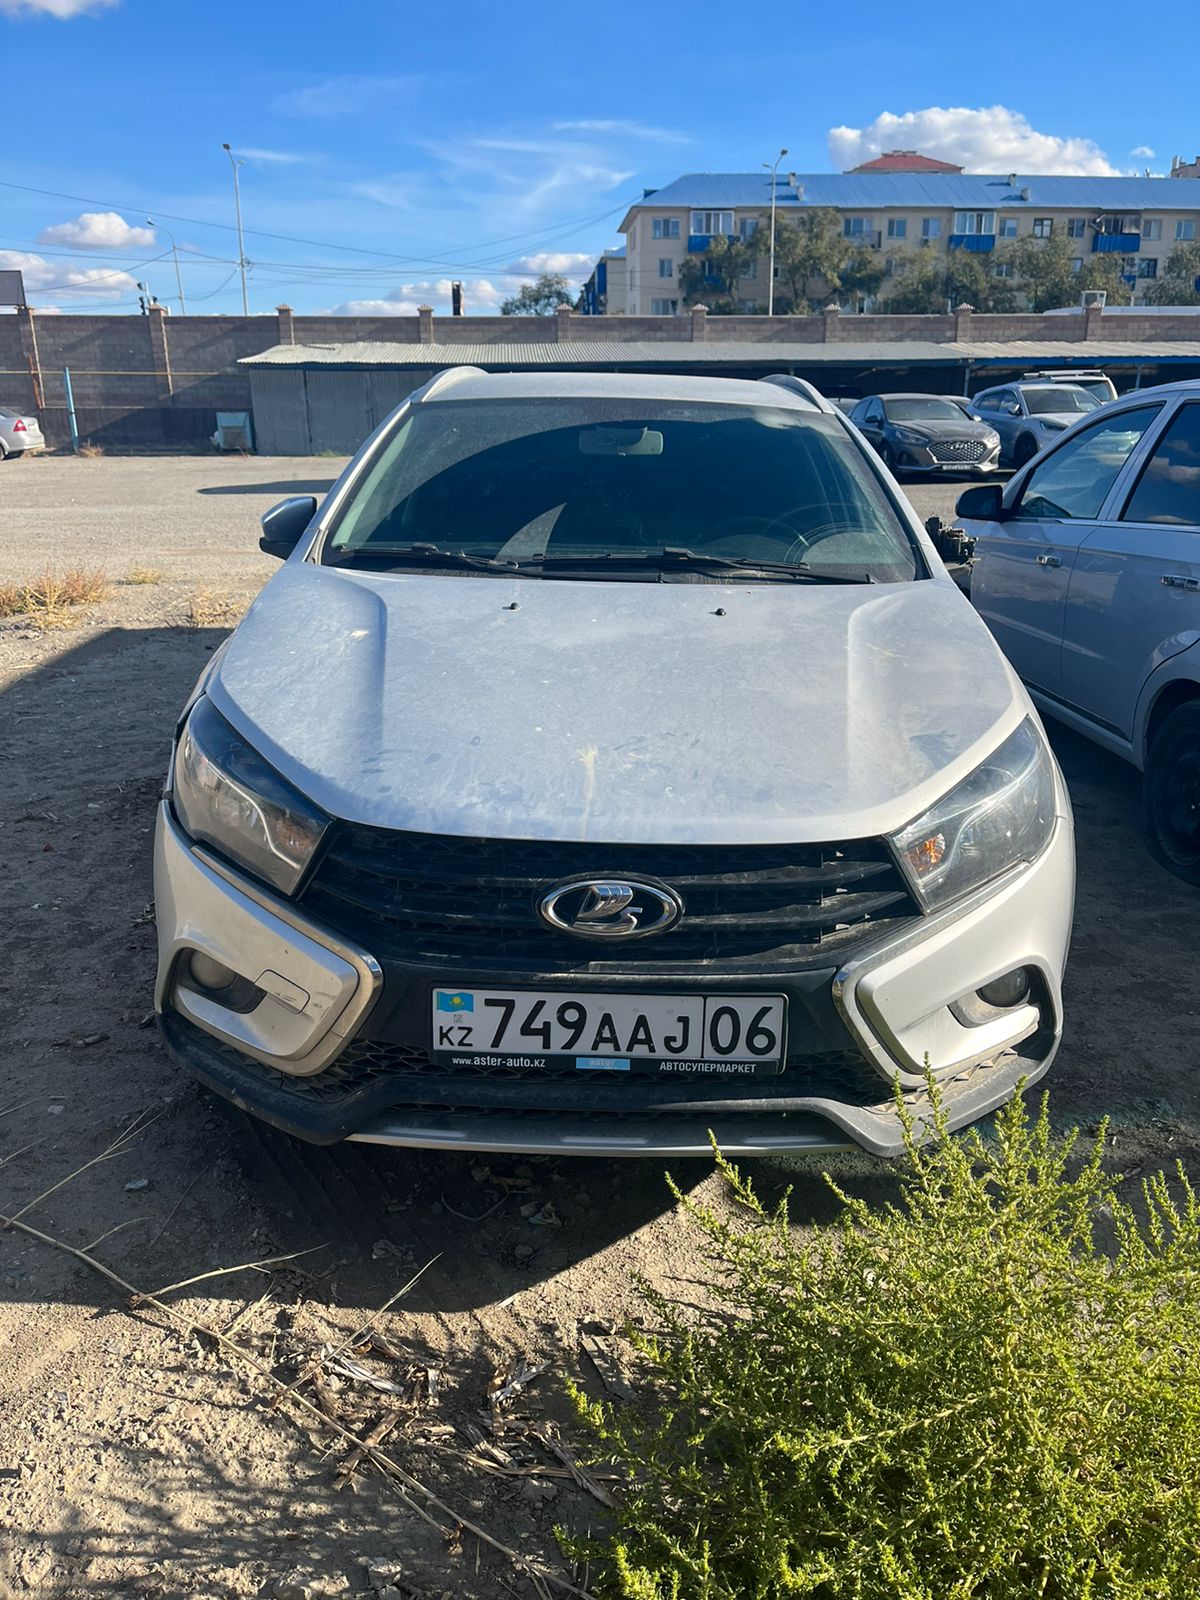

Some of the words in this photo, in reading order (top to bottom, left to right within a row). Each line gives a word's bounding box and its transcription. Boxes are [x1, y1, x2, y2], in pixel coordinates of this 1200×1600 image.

[439, 1025, 473, 1047] KZ
[708, 1006, 777, 1056] 06
[452, 1055, 546, 1069] www.aster-auto.kz
[659, 1062, 757, 1074] АВТОСУПЕРМАРКЕТ
